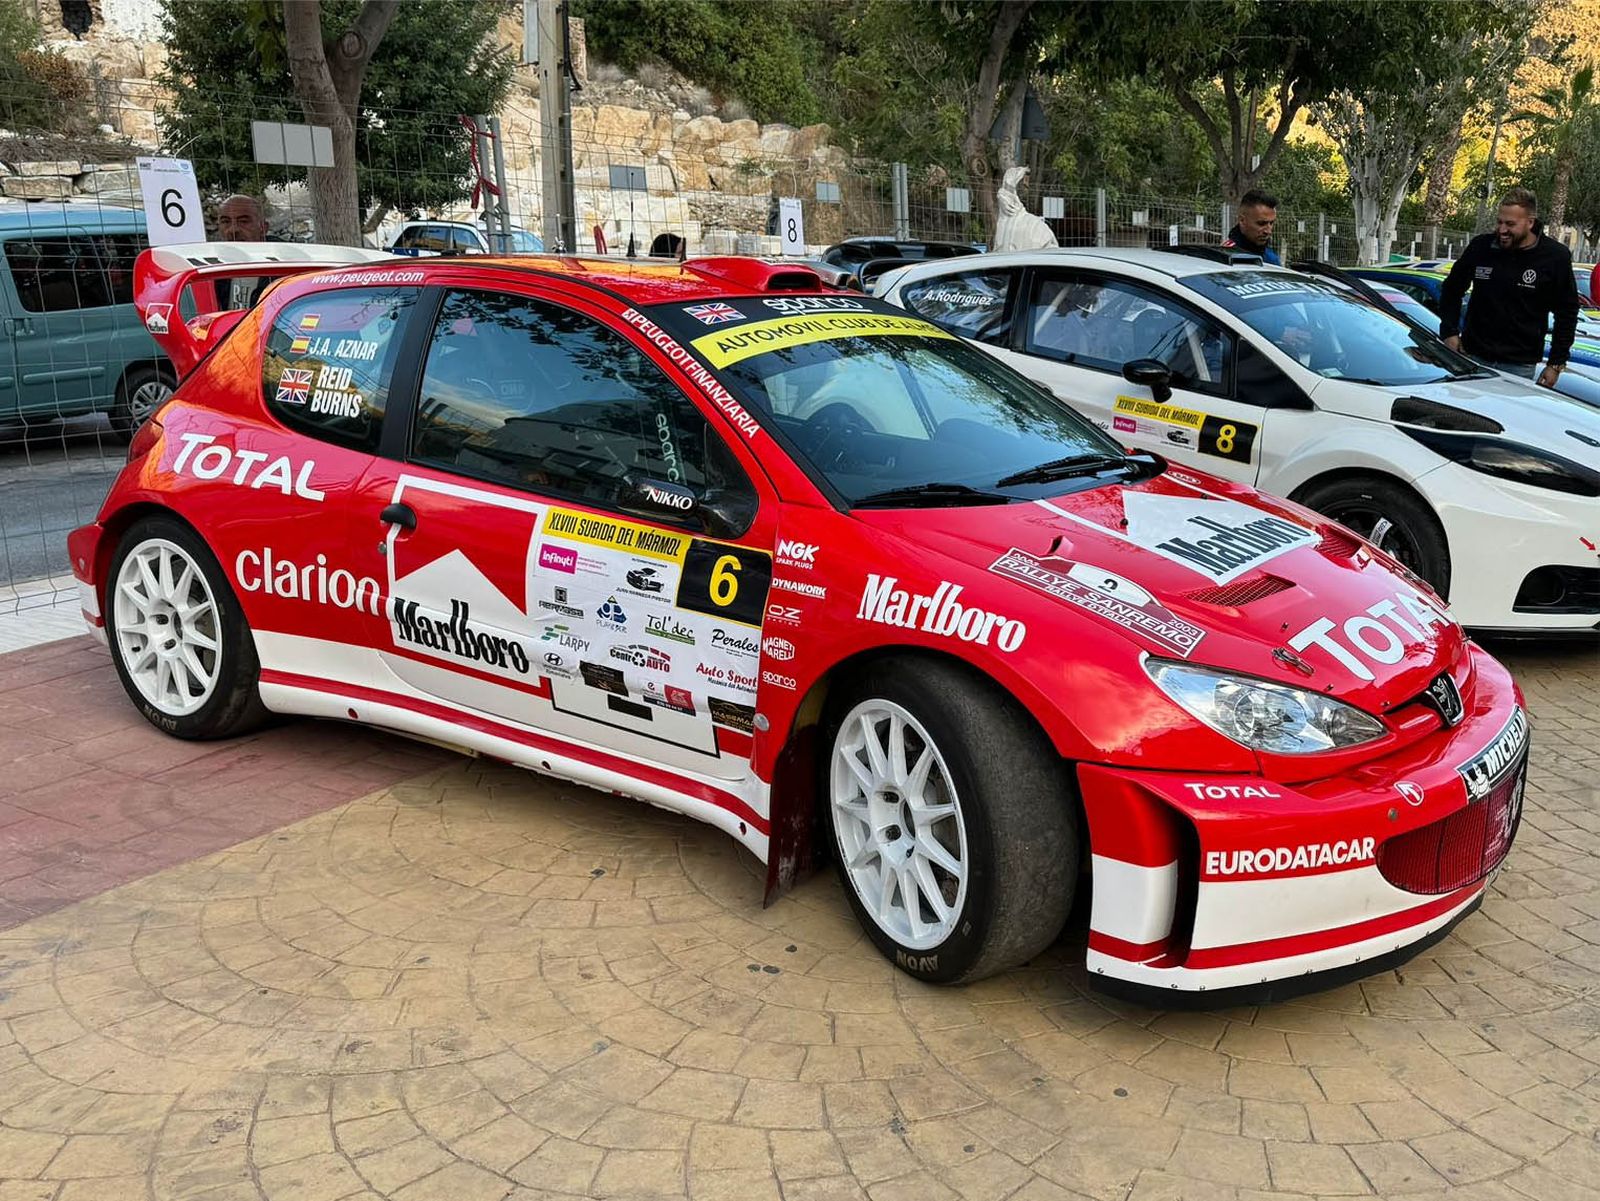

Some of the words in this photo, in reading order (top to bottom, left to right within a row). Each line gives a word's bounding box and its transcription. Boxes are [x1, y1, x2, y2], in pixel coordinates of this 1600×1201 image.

[161, 188, 186, 228] 6
[788, 218, 797, 243] 8
[312, 271, 424, 285] www.peugeot.com
[716, 320, 829, 354] AUTOMOVIL
[829, 318, 876, 330] CLUB
[876, 318, 898, 330] DE
[310, 337, 330, 355] J.A.
[334, 339, 378, 361] AZNAR
[317, 366, 352, 390] REID
[310, 389, 362, 418] BURNS
[655, 413, 679, 482] sparc
[1216, 424, 1236, 453] 8
[173, 433, 325, 502] TOTAL
[646, 488, 693, 510] NIKKO
[549, 512, 578, 533] XLVIII
[578, 518, 616, 542] SUBIDA
[616, 526, 635, 547] DEL
[635, 529, 681, 556] MÁRMOL
[1156, 515, 1309, 577] Marlboro
[776, 557, 793, 566] SPARK
[795, 561, 813, 570] PLUGS
[777, 539, 820, 563] NGK
[235, 547, 380, 616] Clarion
[709, 554, 742, 607] 6
[772, 577, 827, 597] DYNAWORK
[1098, 578, 1118, 593] 2
[856, 573, 1026, 653] Marlboro
[999, 559, 1081, 593] RALLYE
[1084, 591, 1193, 647] SANREMO
[393, 596, 530, 674] Marlboro
[1167, 618, 1198, 637] 2003
[560, 633, 590, 652] LARPY
[711, 628, 759, 653] Perales
[696, 662, 724, 679] Auto
[727, 669, 757, 687] Sport
[763, 671, 796, 689] sparco
[1184, 782, 1281, 800] TOTAL
[1205, 836, 1376, 876] EURODATACAR
